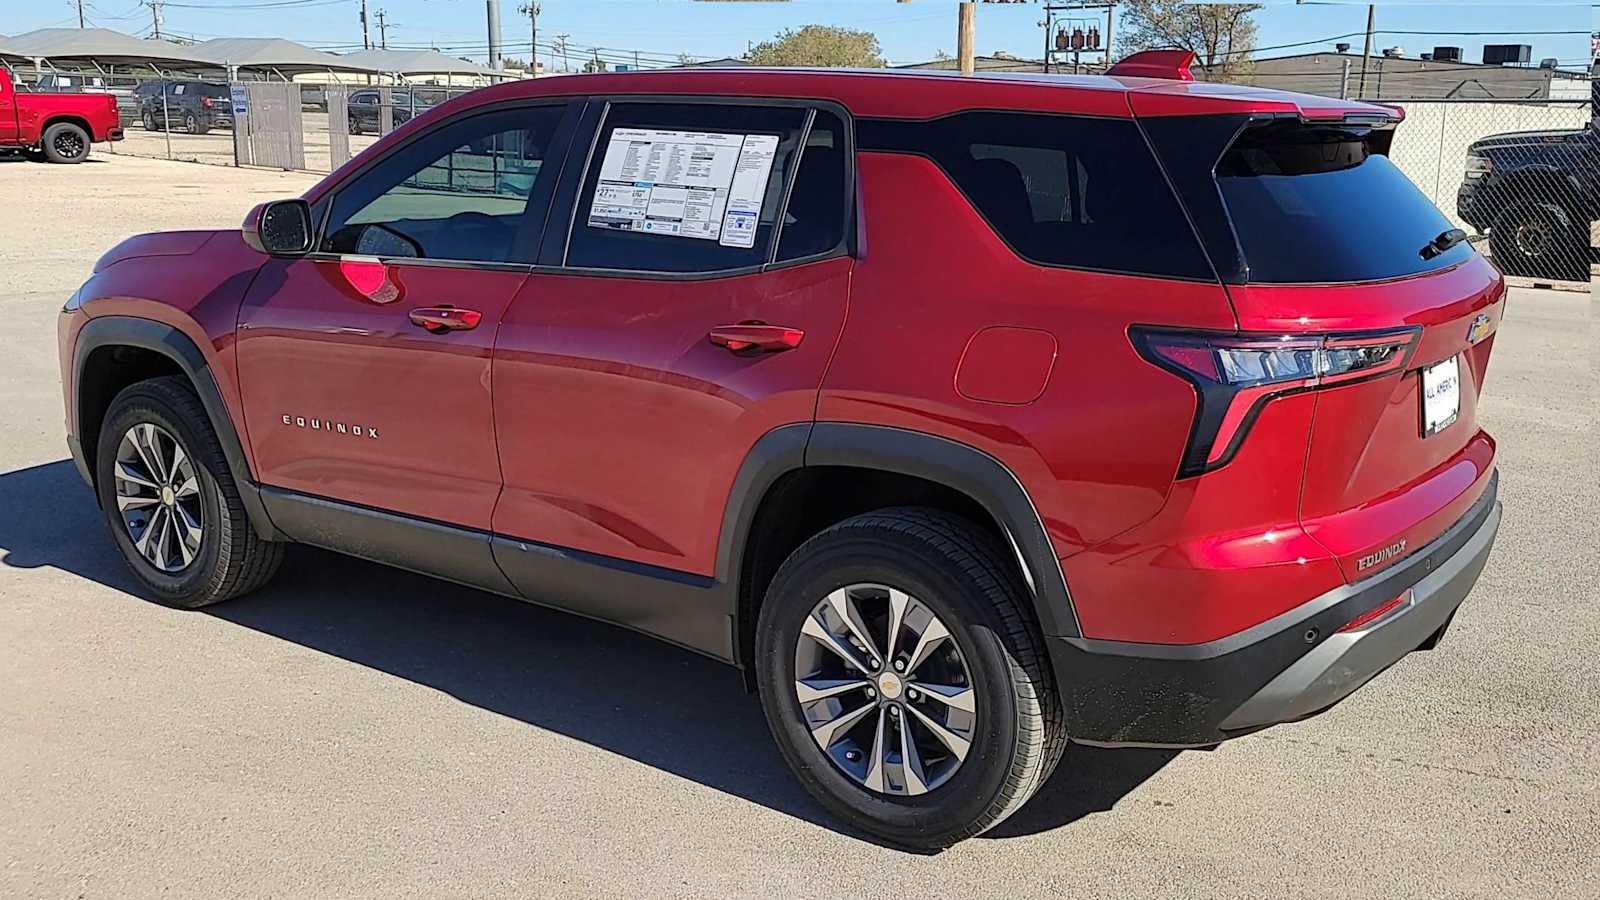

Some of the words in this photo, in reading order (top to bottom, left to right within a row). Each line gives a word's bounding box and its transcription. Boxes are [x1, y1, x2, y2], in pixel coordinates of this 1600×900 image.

[1436, 376, 1457, 394] AMERICN
[282, 414, 379, 439] EQUINOX
[1357, 539, 1408, 572] EQUINOX
